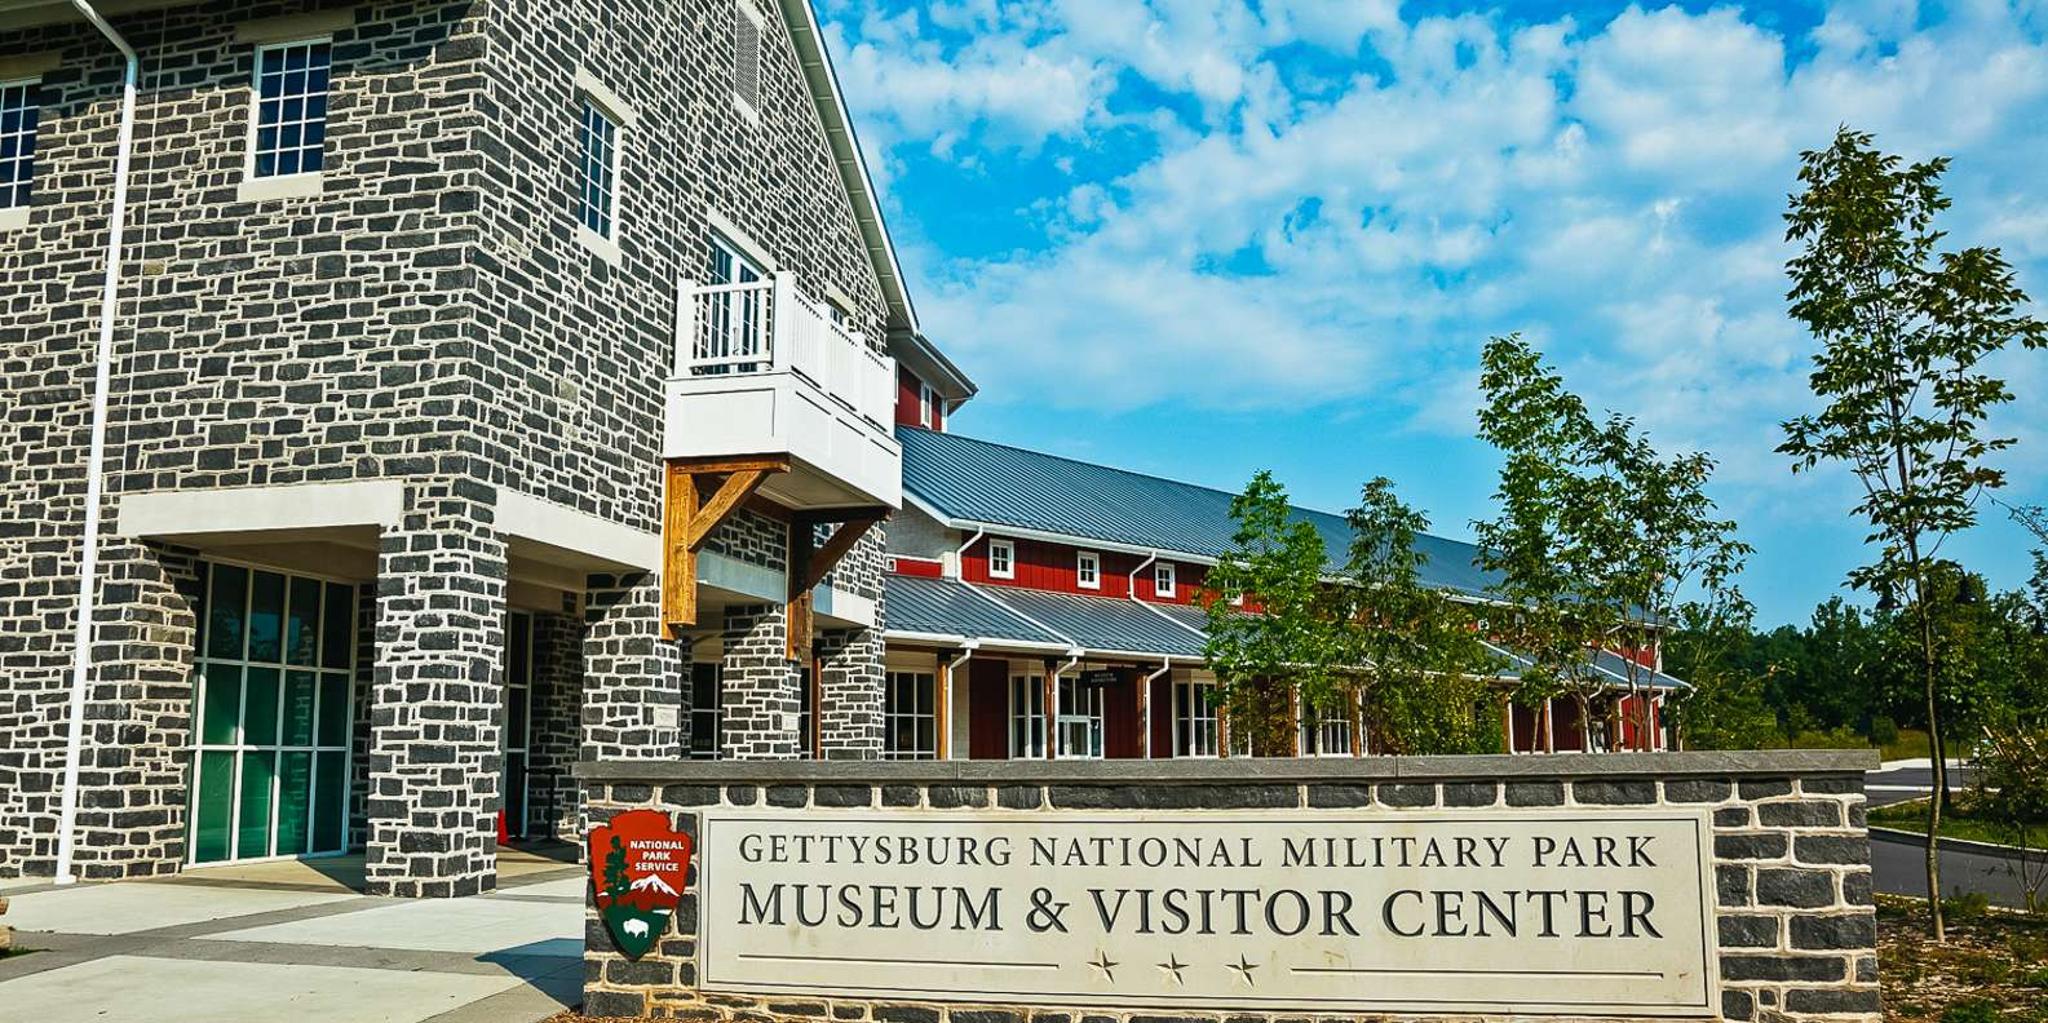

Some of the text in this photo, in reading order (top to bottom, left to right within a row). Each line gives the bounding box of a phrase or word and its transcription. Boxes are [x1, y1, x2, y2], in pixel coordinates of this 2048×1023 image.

[630, 840, 684, 849] NATIONAL
[738, 833, 1657, 868] GETTYSBURG NATIONAL MILITARY PARK
[642, 851, 671, 860] PARK
[635, 862, 679, 871] SERVICE
[737, 883, 1664, 939] MUSEUM & VISITOR CENTER
